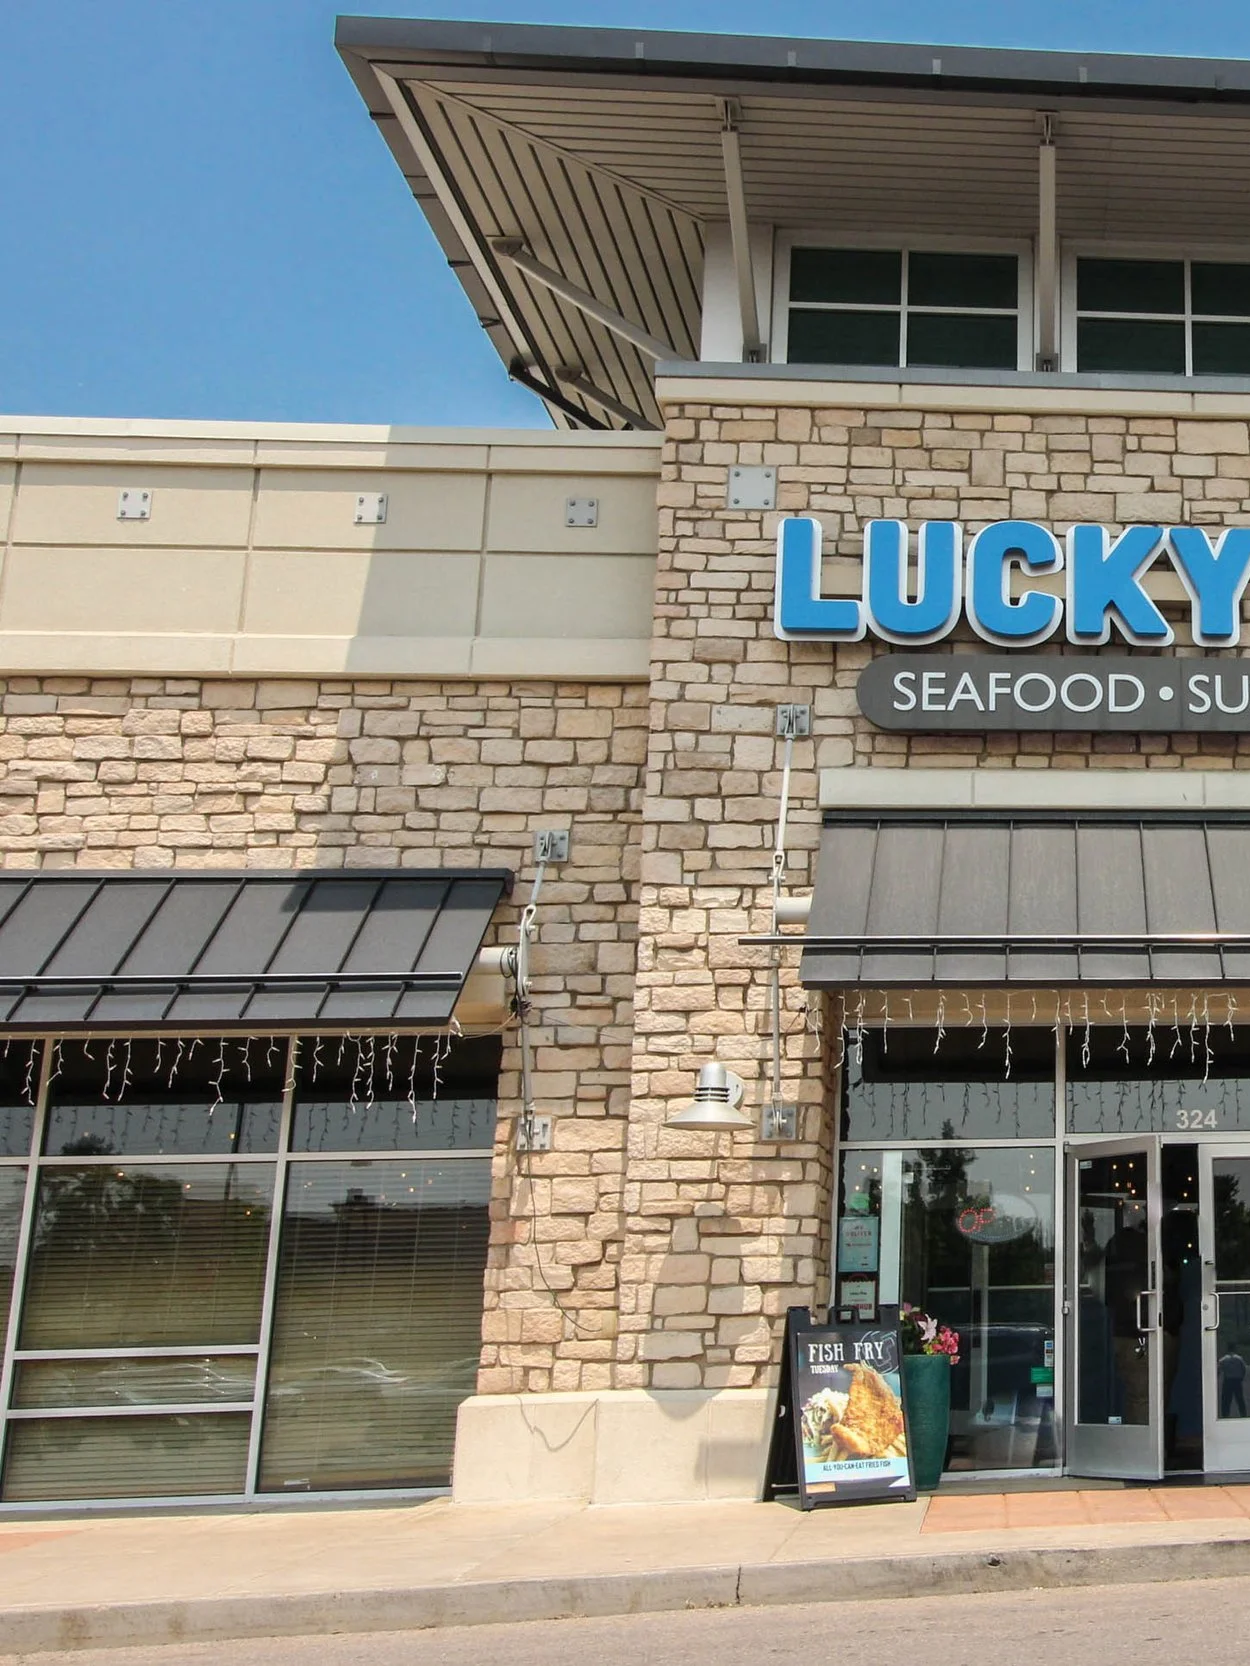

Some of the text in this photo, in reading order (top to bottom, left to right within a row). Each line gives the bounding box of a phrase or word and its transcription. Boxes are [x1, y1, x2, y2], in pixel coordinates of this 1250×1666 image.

[893, 671, 1146, 713] SEAFOOD
[1176, 1109, 1218, 1129] 324
[808, 1341, 884, 1362] FISH FRY
[810, 1364, 838, 1374] TUESDAY
